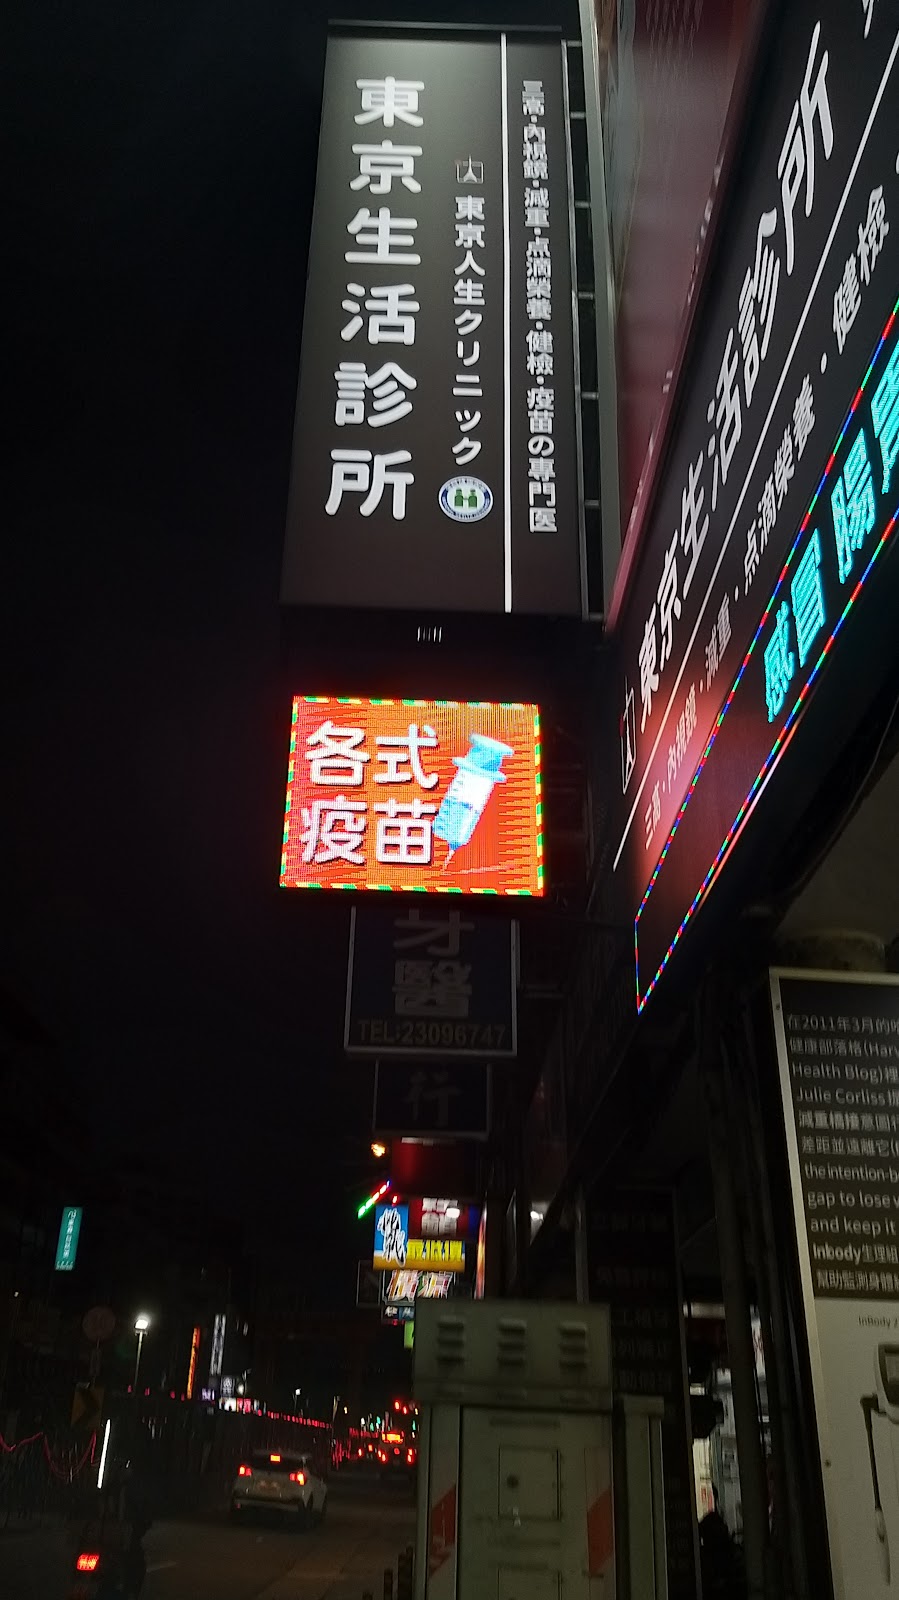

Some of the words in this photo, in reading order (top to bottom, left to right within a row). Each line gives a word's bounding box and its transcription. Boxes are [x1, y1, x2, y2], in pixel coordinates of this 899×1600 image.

[324, 76, 424, 520] 東京生活診所
[451, 195, 485, 465] 東京人生クリニック
[639, 20, 834, 734] 東京生活診所
[305, 721, 438, 789] 各式
[300, 795, 437, 864] 疫苗
[792, 1062, 841, 1079] Health
[796, 1086, 832, 1103] Julie
[808, 1191, 836, 1210] gap
[840, 1190, 855, 1207] to
[859, 1189, 891, 1208] lose
[811, 1215, 840, 1233] and
[844, 1216, 882, 1239] keep
[885, 1217, 897, 1236] it
